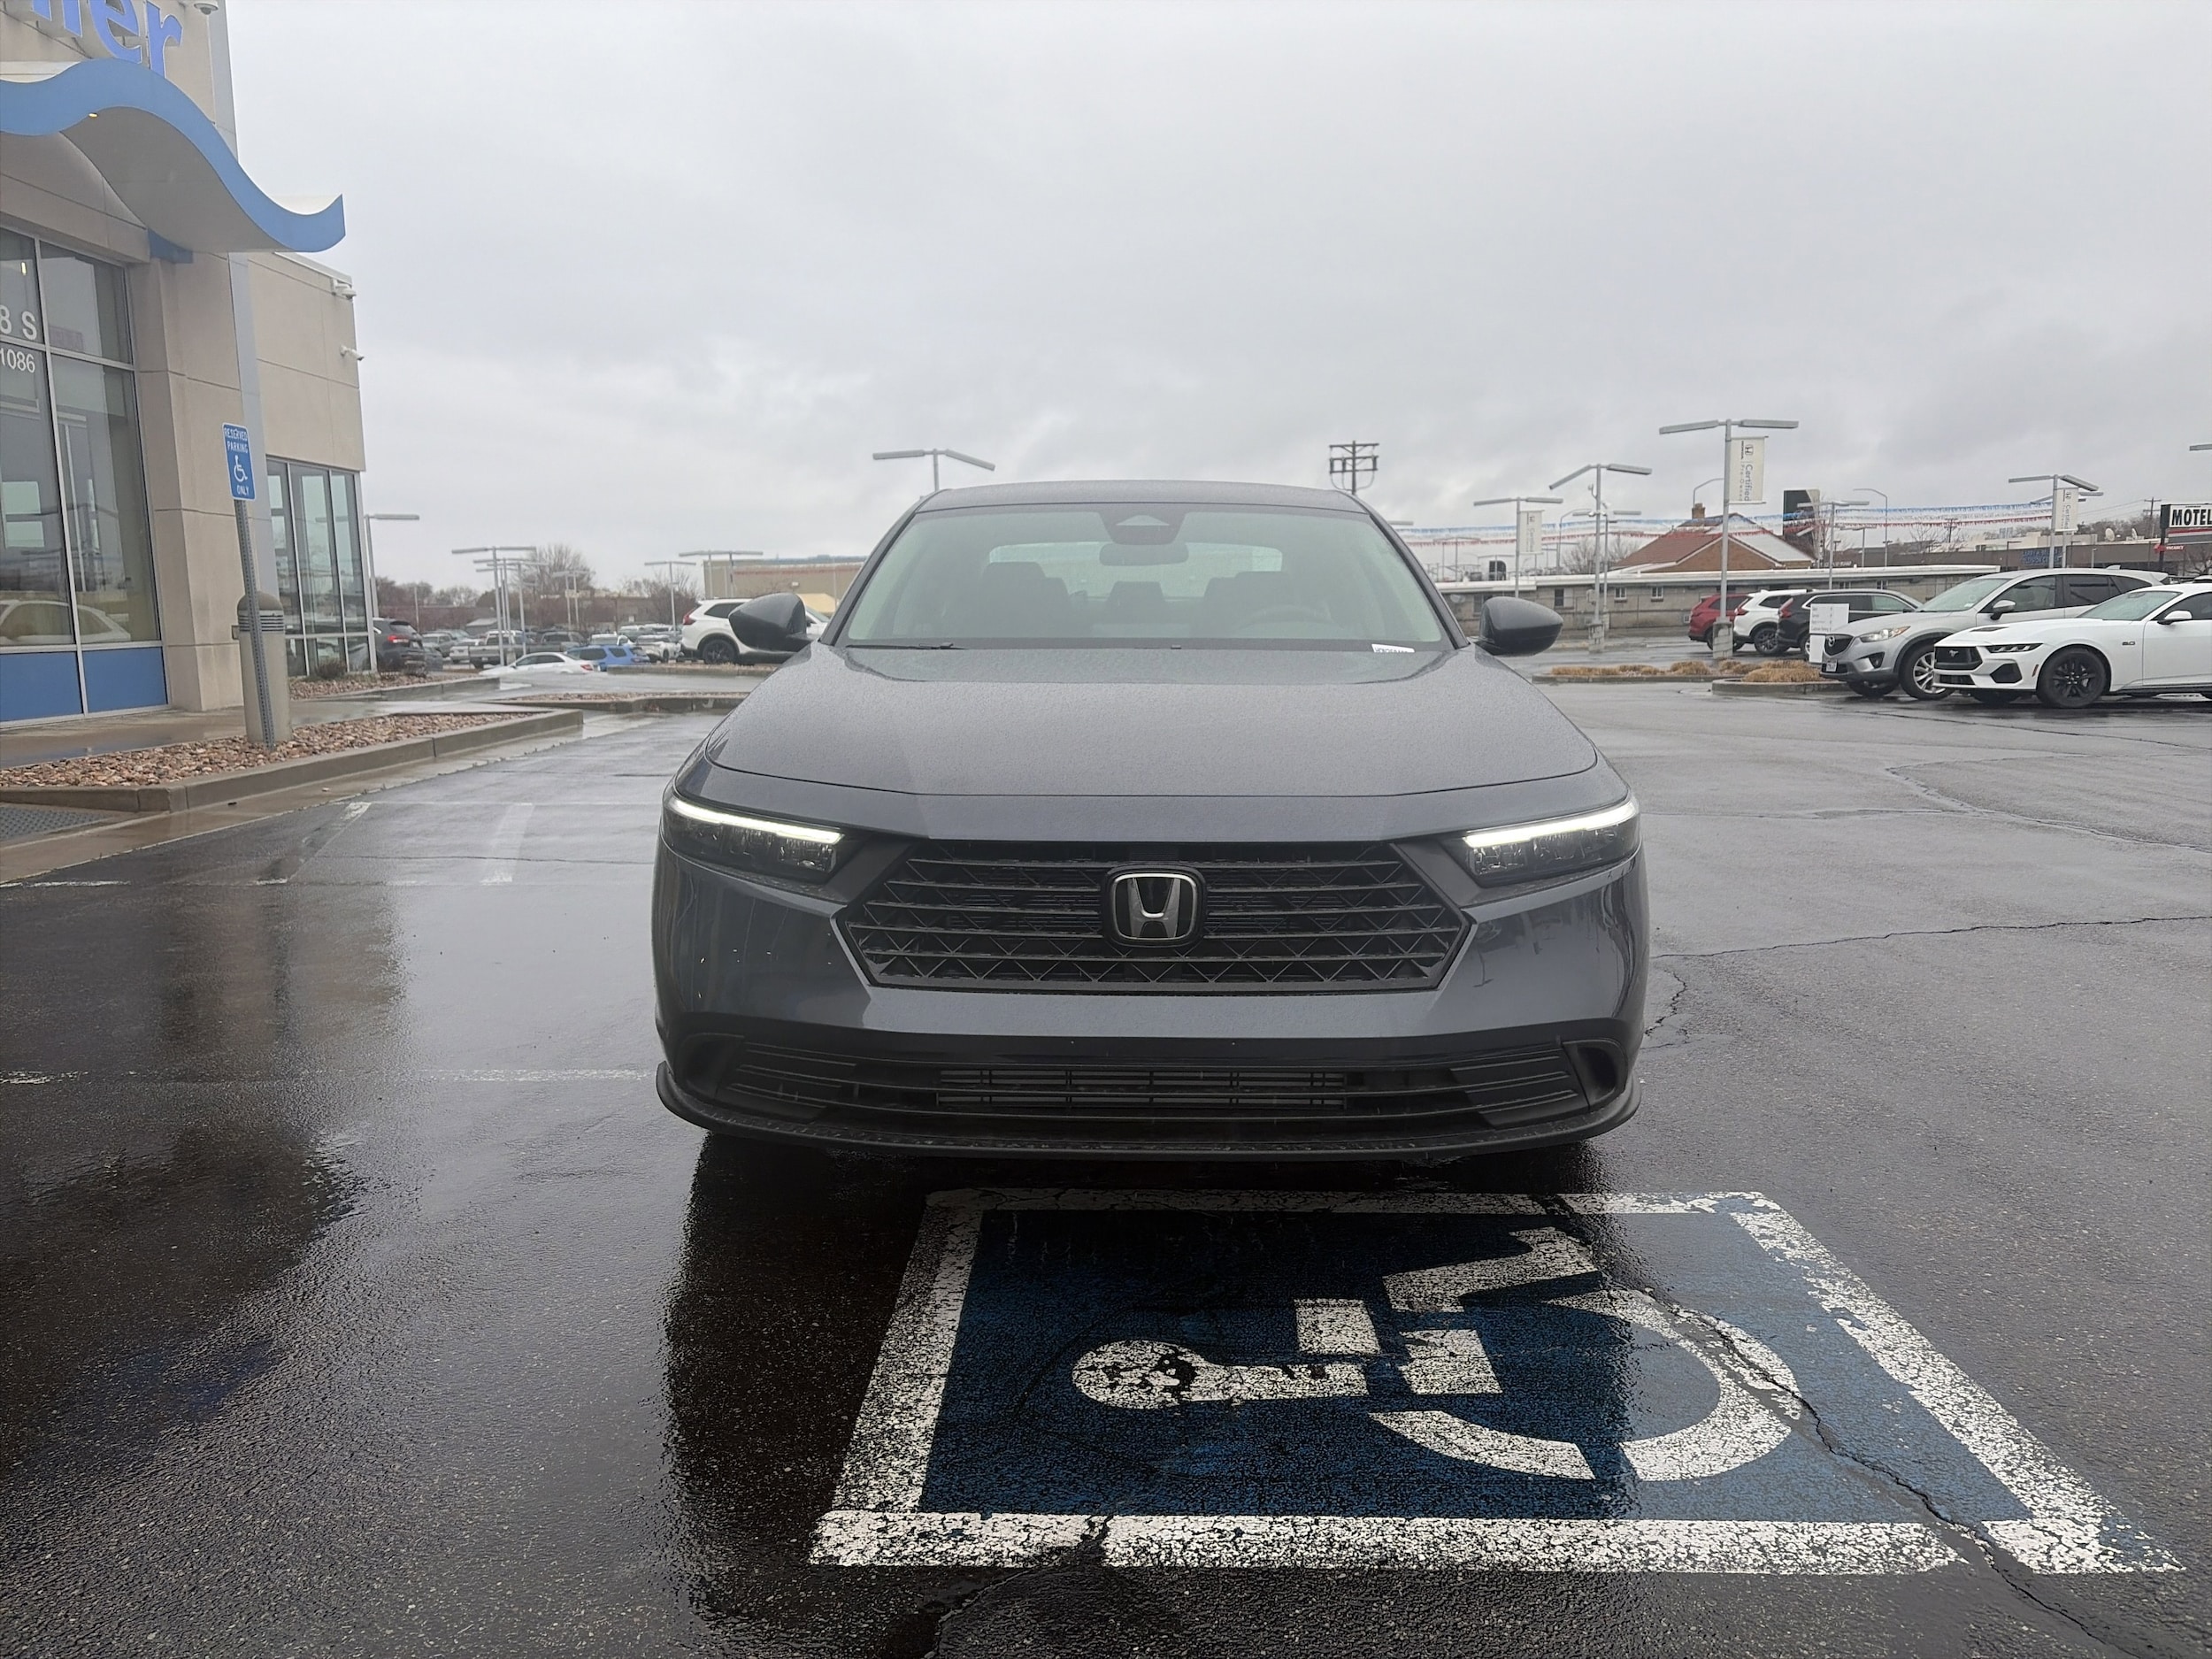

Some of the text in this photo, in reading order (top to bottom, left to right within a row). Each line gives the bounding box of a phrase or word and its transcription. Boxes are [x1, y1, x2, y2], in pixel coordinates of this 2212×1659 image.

[32, 0, 183, 79] er
[22, 311, 37, 341] S
[224, 427, 248, 442] RESERVED
[227, 441, 248, 453] PARKING
[236, 485, 249, 495] ONLY
[1744, 465, 1753, 501] Certified
[2171, 509, 2212, 526] MOTEL
